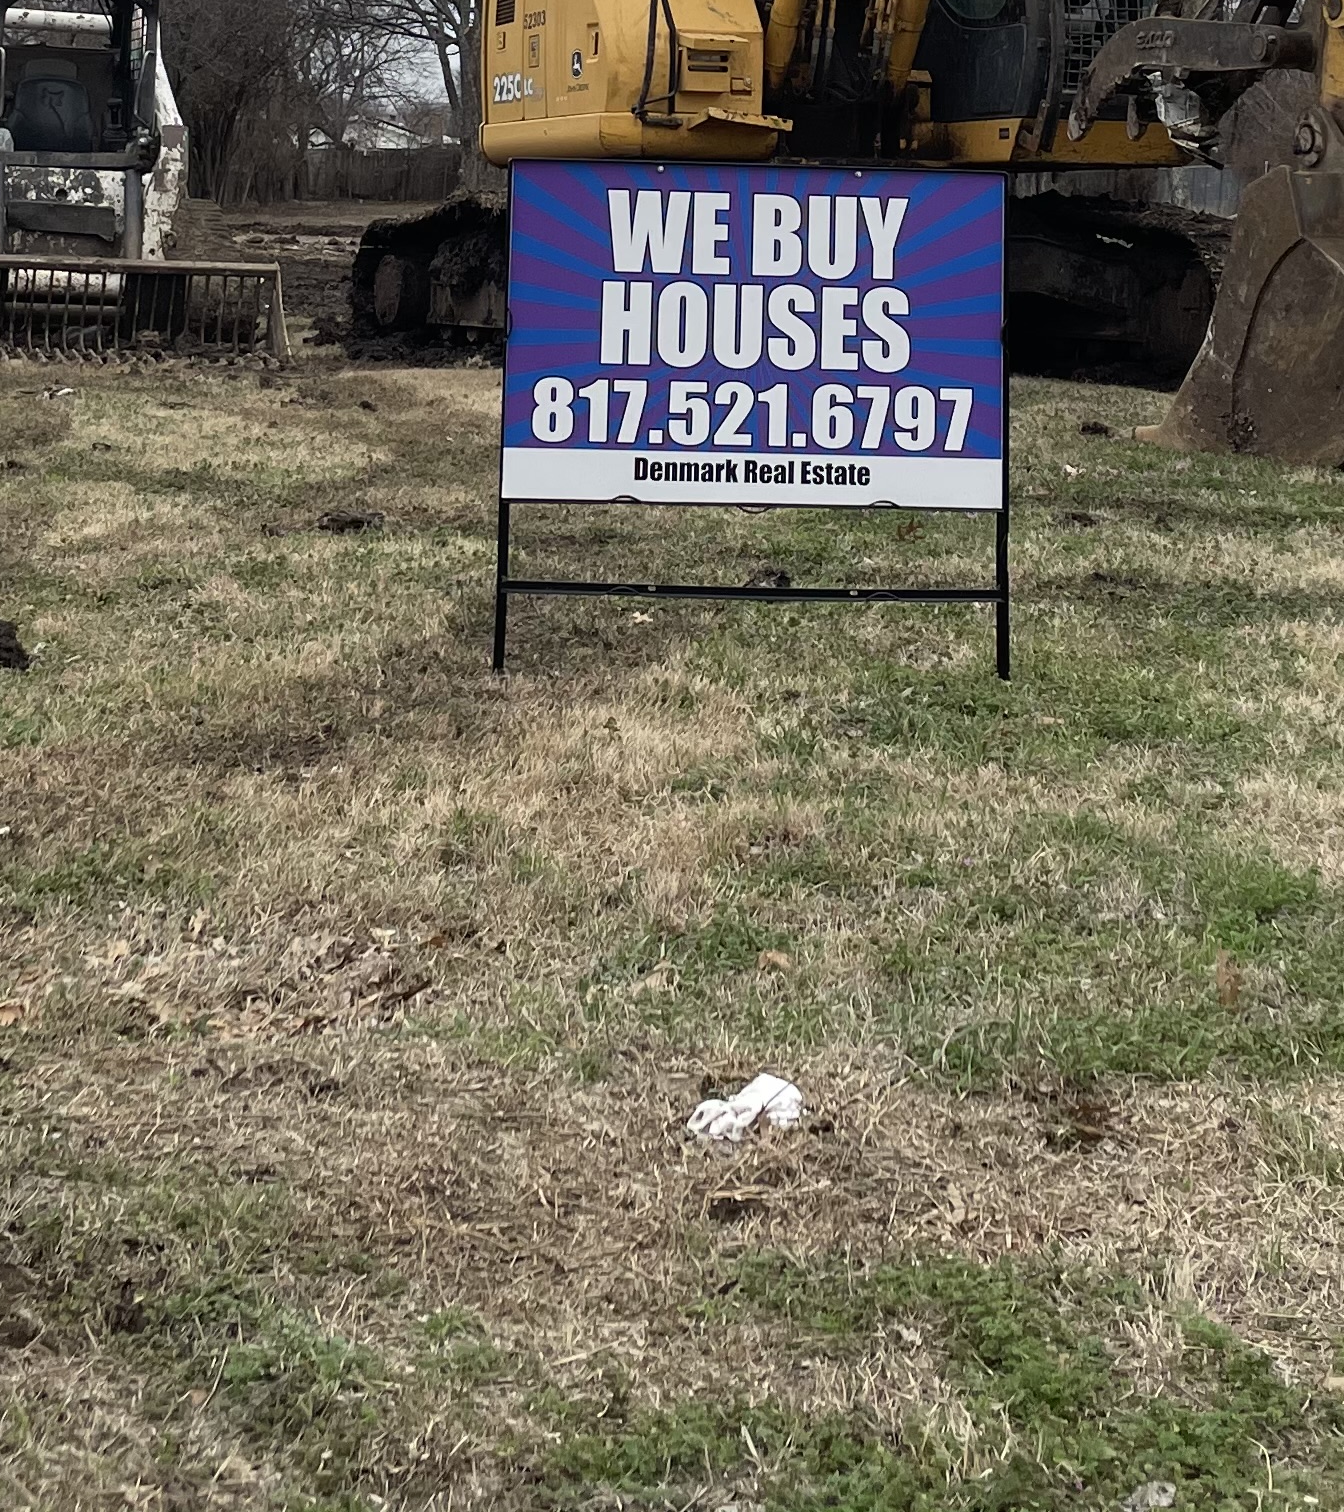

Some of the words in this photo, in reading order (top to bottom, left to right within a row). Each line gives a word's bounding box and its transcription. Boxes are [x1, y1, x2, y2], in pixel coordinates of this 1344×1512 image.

[493, 73, 522, 102] 225C
[607, 189, 732, 276] WE
[752, 193, 910, 280] BUY
[600, 280, 912, 374] HOUSES
[530, 377, 974, 453] 817.521.6797
[634, 457, 738, 485] Denmark
[744, 461, 795, 486] Real
[801, 463, 871, 487] Estate
